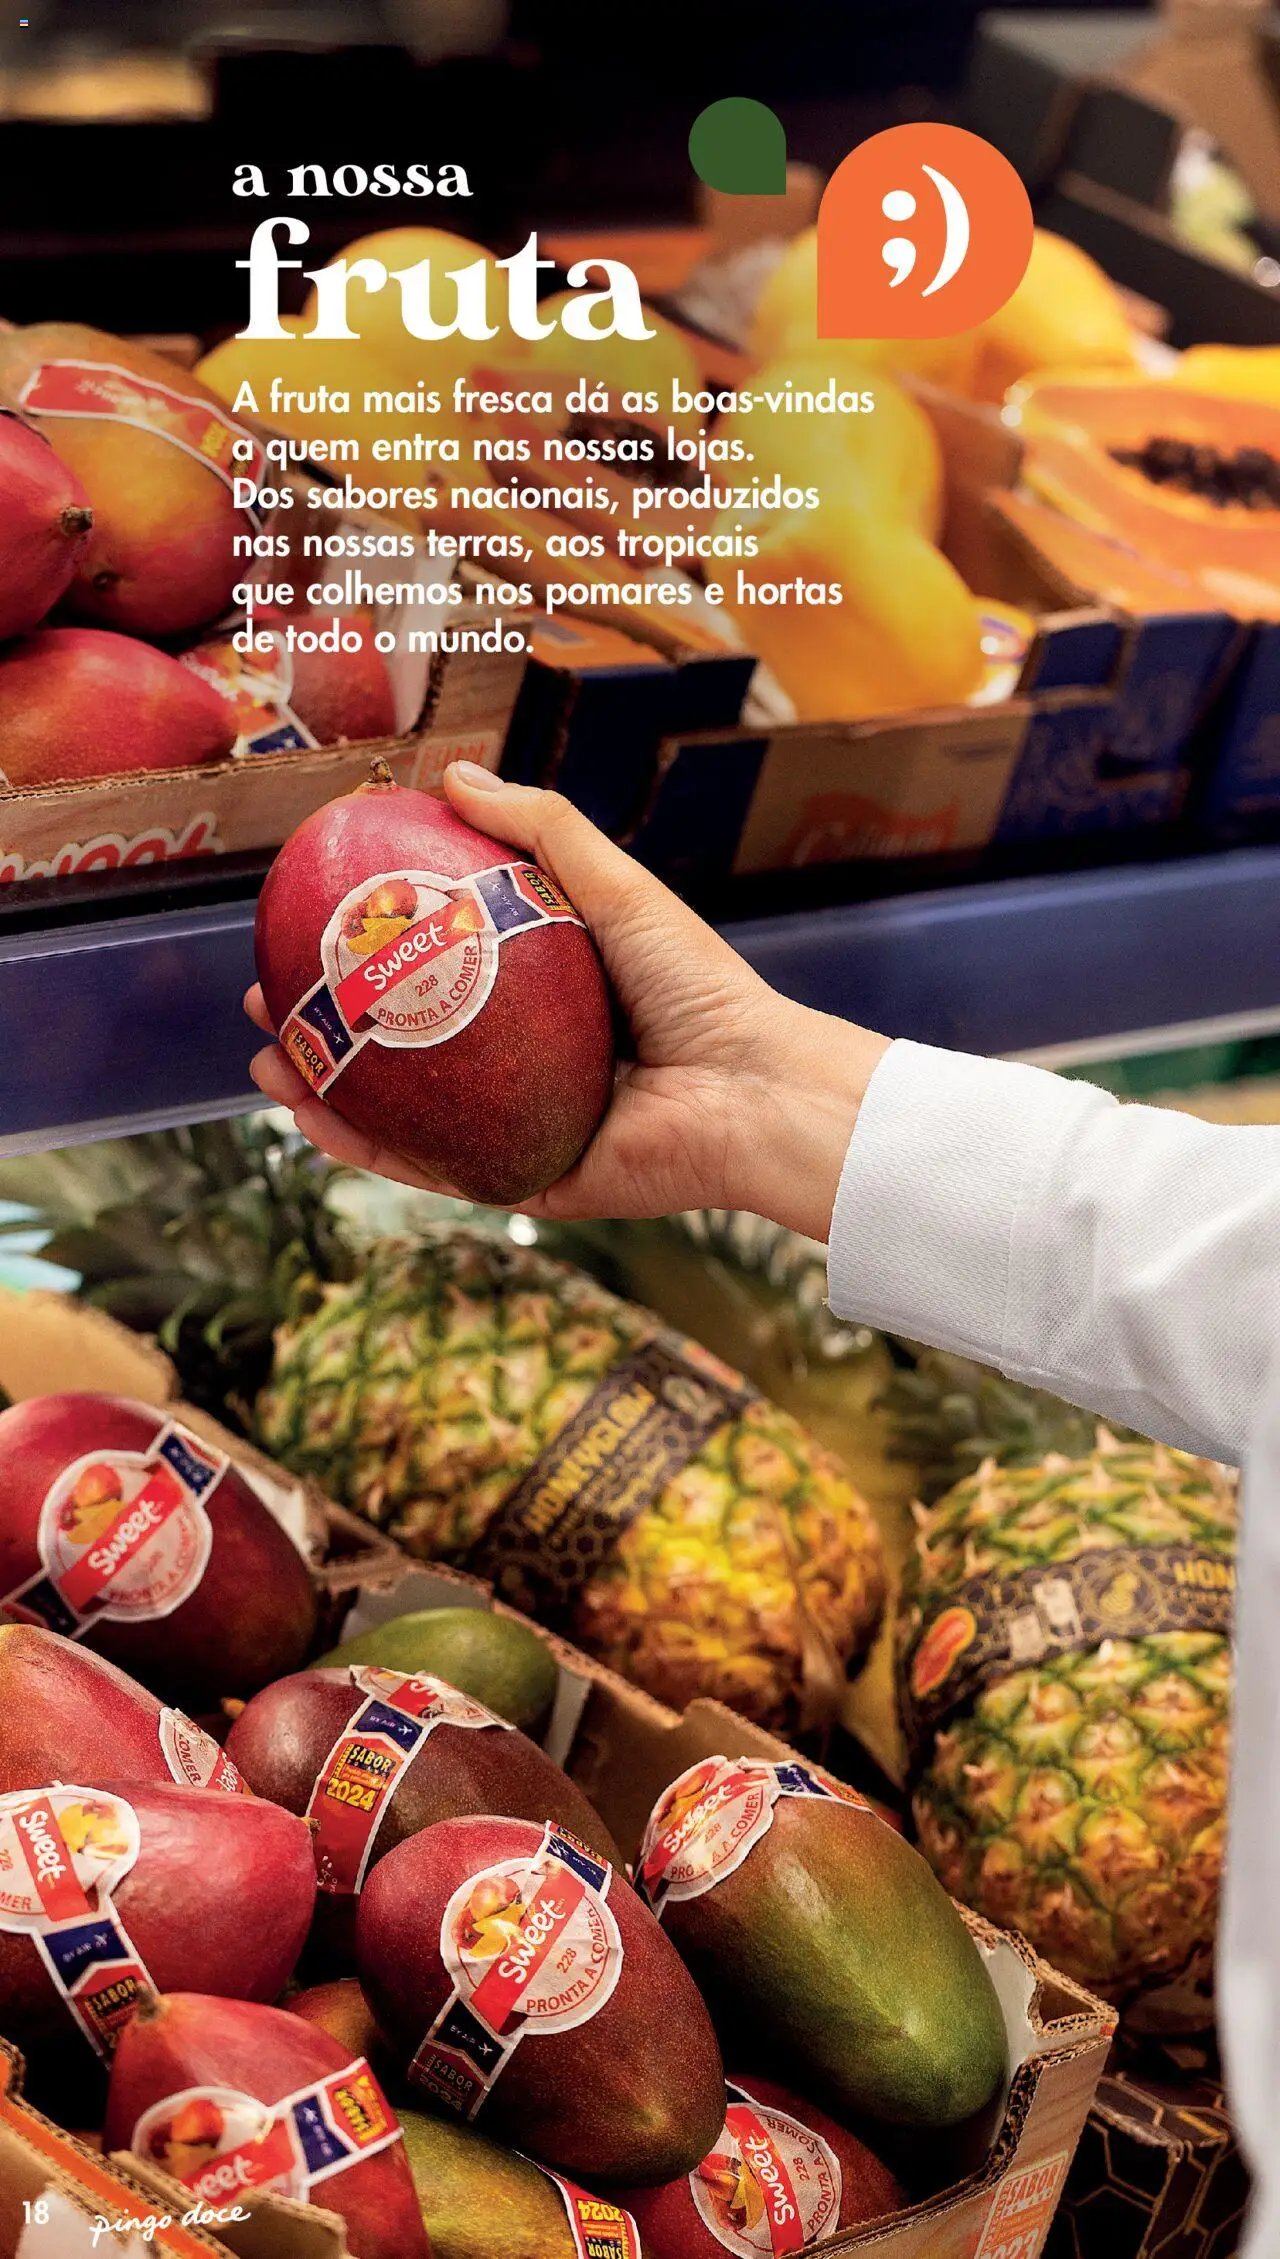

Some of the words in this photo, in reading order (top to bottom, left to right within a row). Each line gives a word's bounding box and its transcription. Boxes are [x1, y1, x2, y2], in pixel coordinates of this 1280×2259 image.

[363, 922, 447, 991] Sweet
[377, 1007, 440, 1027] PRONTA
[439, 999, 452, 1015] A
[449, 945, 478, 1002] COMER
[414, 974, 439, 997] 228
[295, 1035, 325, 1074] SABOR
[88, 1499, 163, 1576] Sweet
[349, 1745, 393, 1772] SABOR
[326, 1778, 376, 1811] 2024
[662, 1783, 733, 1854] Sweet
[731, 1792, 761, 1839] COMER
[19, 1810, 67, 1882] Sweet
[498, 1899, 566, 1985] Sweet
[587, 1908, 605, 1964] COMER
[556, 1947, 578, 1974] 228
[584, 1967, 598, 1981] A
[91, 1977, 137, 2012] SABOR
[526, 1980, 589, 2013] PRONTA
[434, 2059, 474, 2092] SABOR
[766, 2117, 817, 2154] COMER
[792, 2156, 811, 2182] 228
[813, 2155, 825, 2167] A
[745, 2135, 795, 2226] Sweet
[577, 2199, 625, 2222] 2024
[807, 2171, 832, 2233] PRONTA
